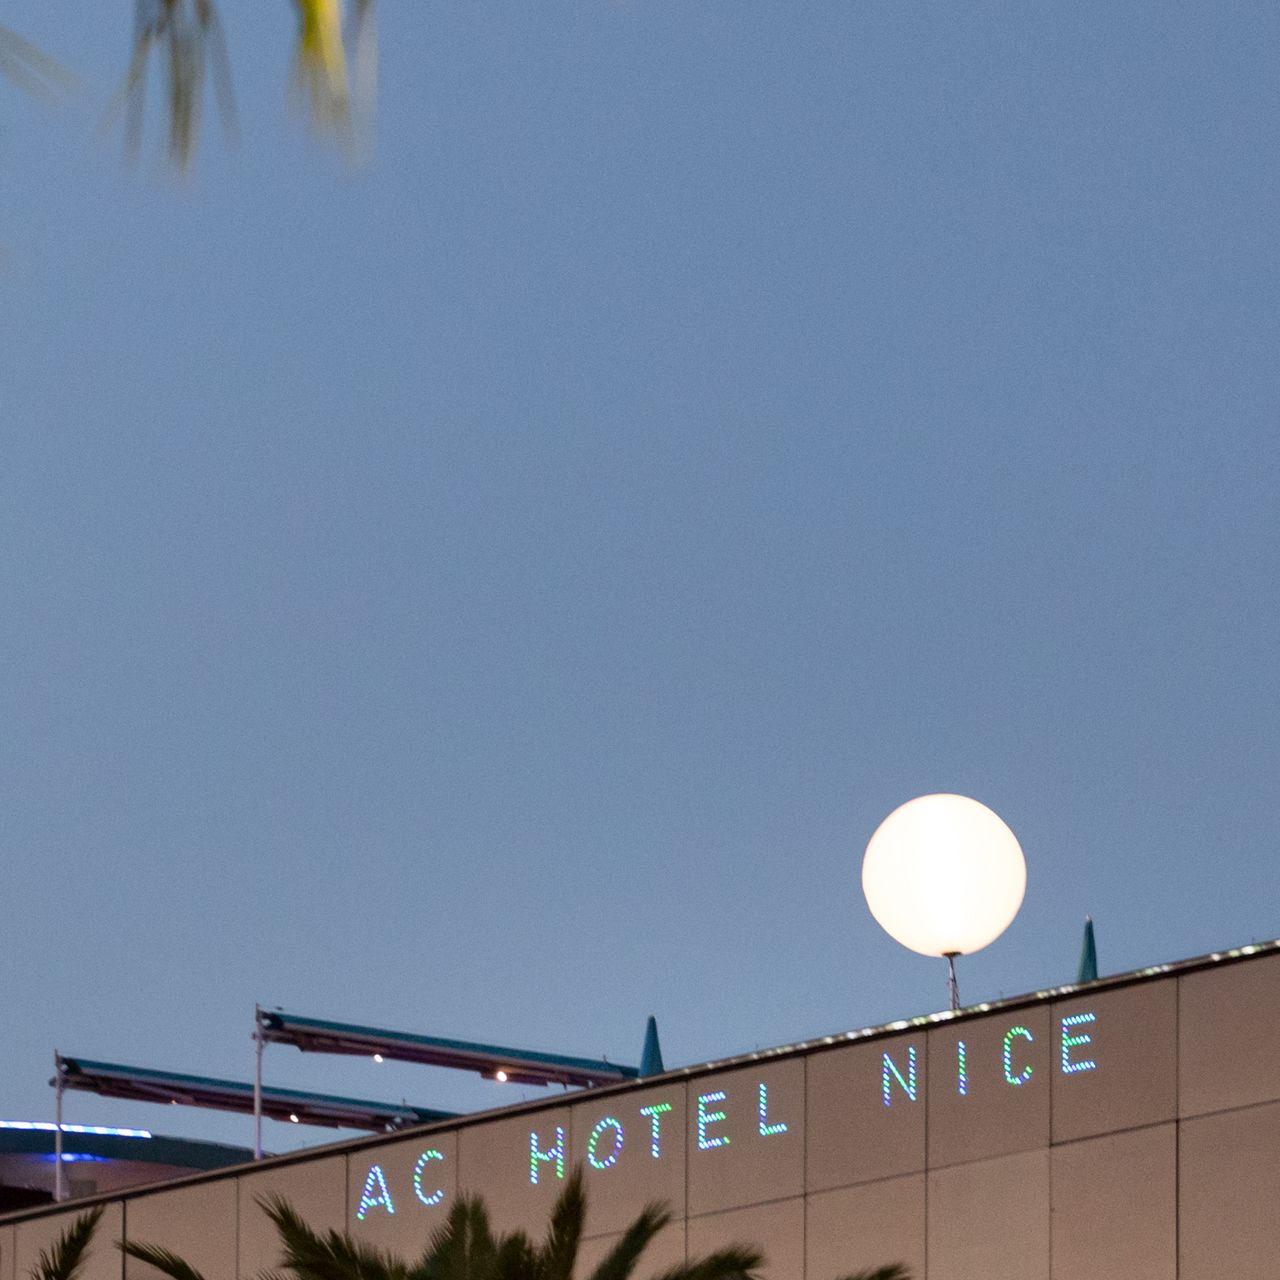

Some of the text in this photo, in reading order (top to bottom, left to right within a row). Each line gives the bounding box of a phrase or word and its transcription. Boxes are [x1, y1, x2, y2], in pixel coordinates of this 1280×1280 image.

[356, 1012, 1097, 1221] AC HOTEL NICE
